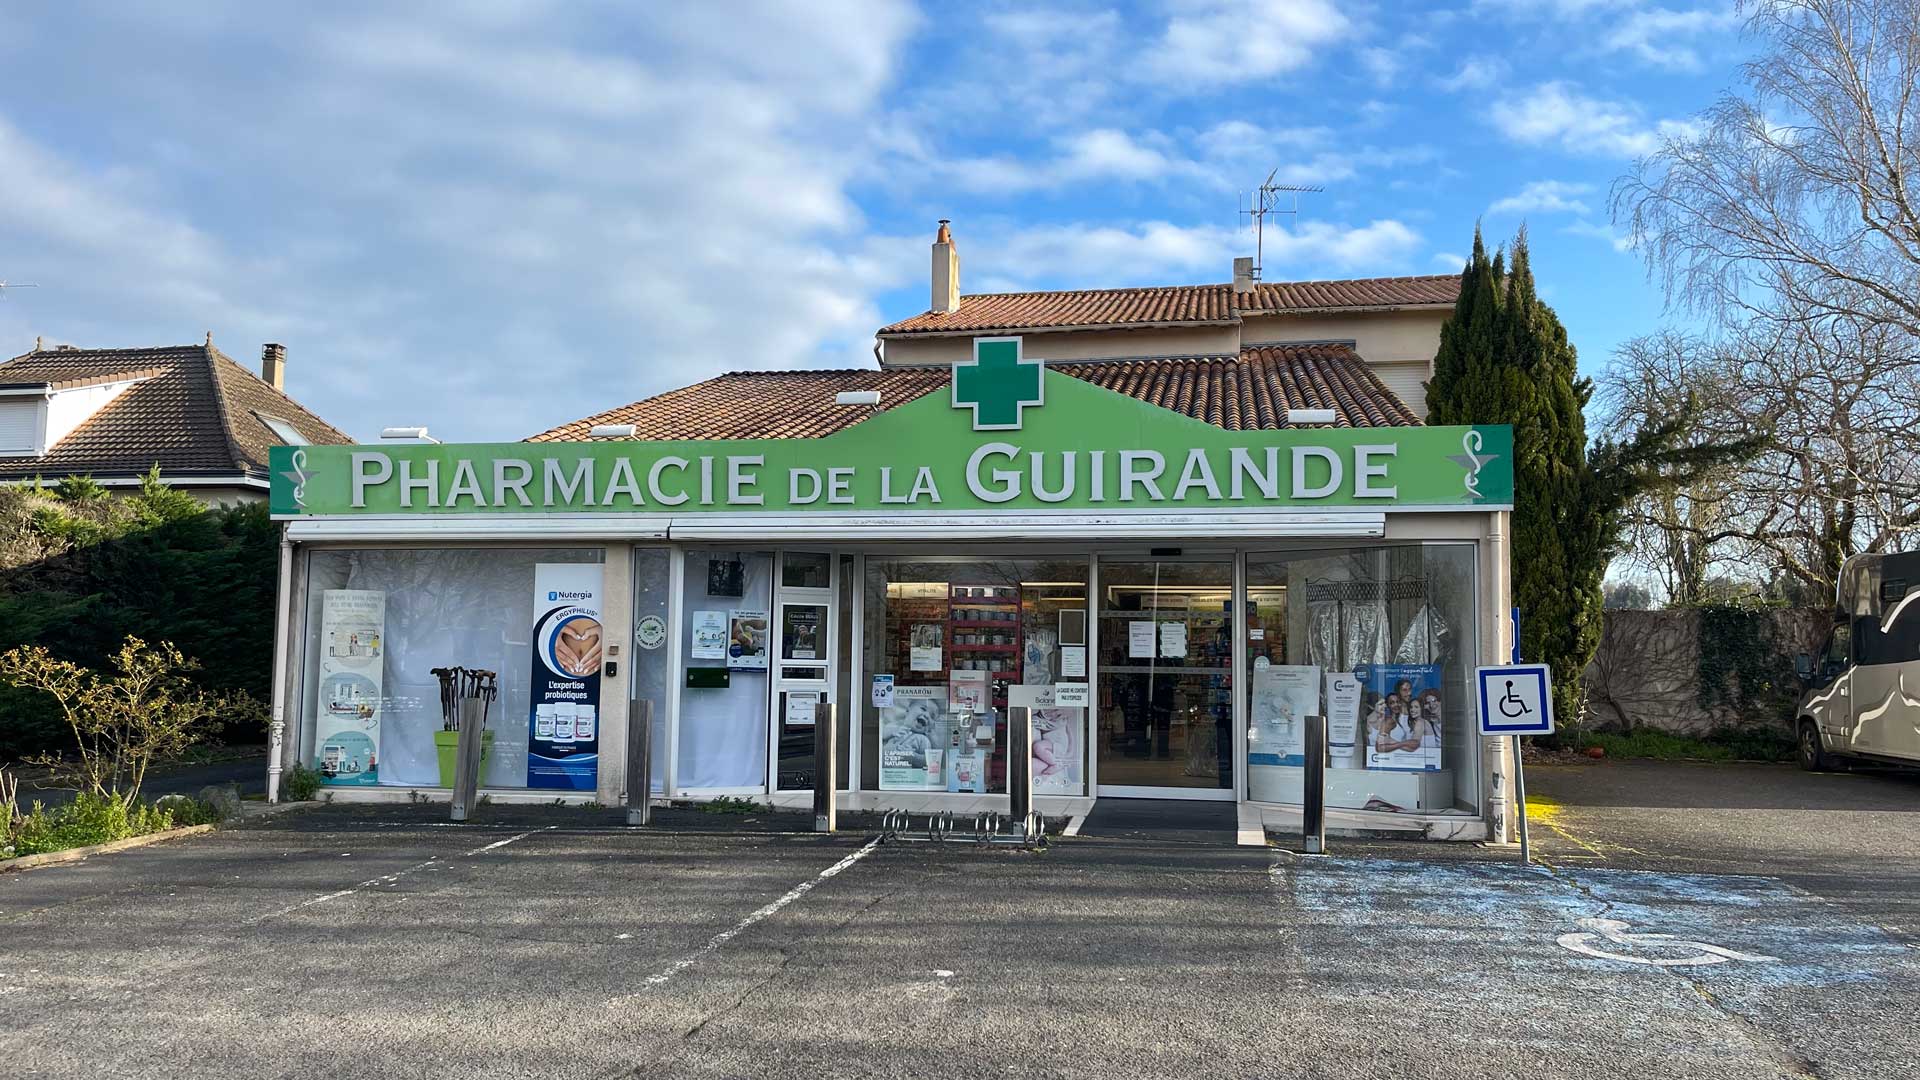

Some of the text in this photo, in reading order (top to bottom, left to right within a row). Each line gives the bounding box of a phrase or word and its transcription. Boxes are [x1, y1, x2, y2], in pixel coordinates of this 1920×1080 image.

[350, 442, 1398, 507] PHARMACIE DE LA GUIRANDE
[558, 590, 593, 600] Nutergia
[548, 680, 585, 691] L'expertise
[545, 690, 588, 700] probiotiques
